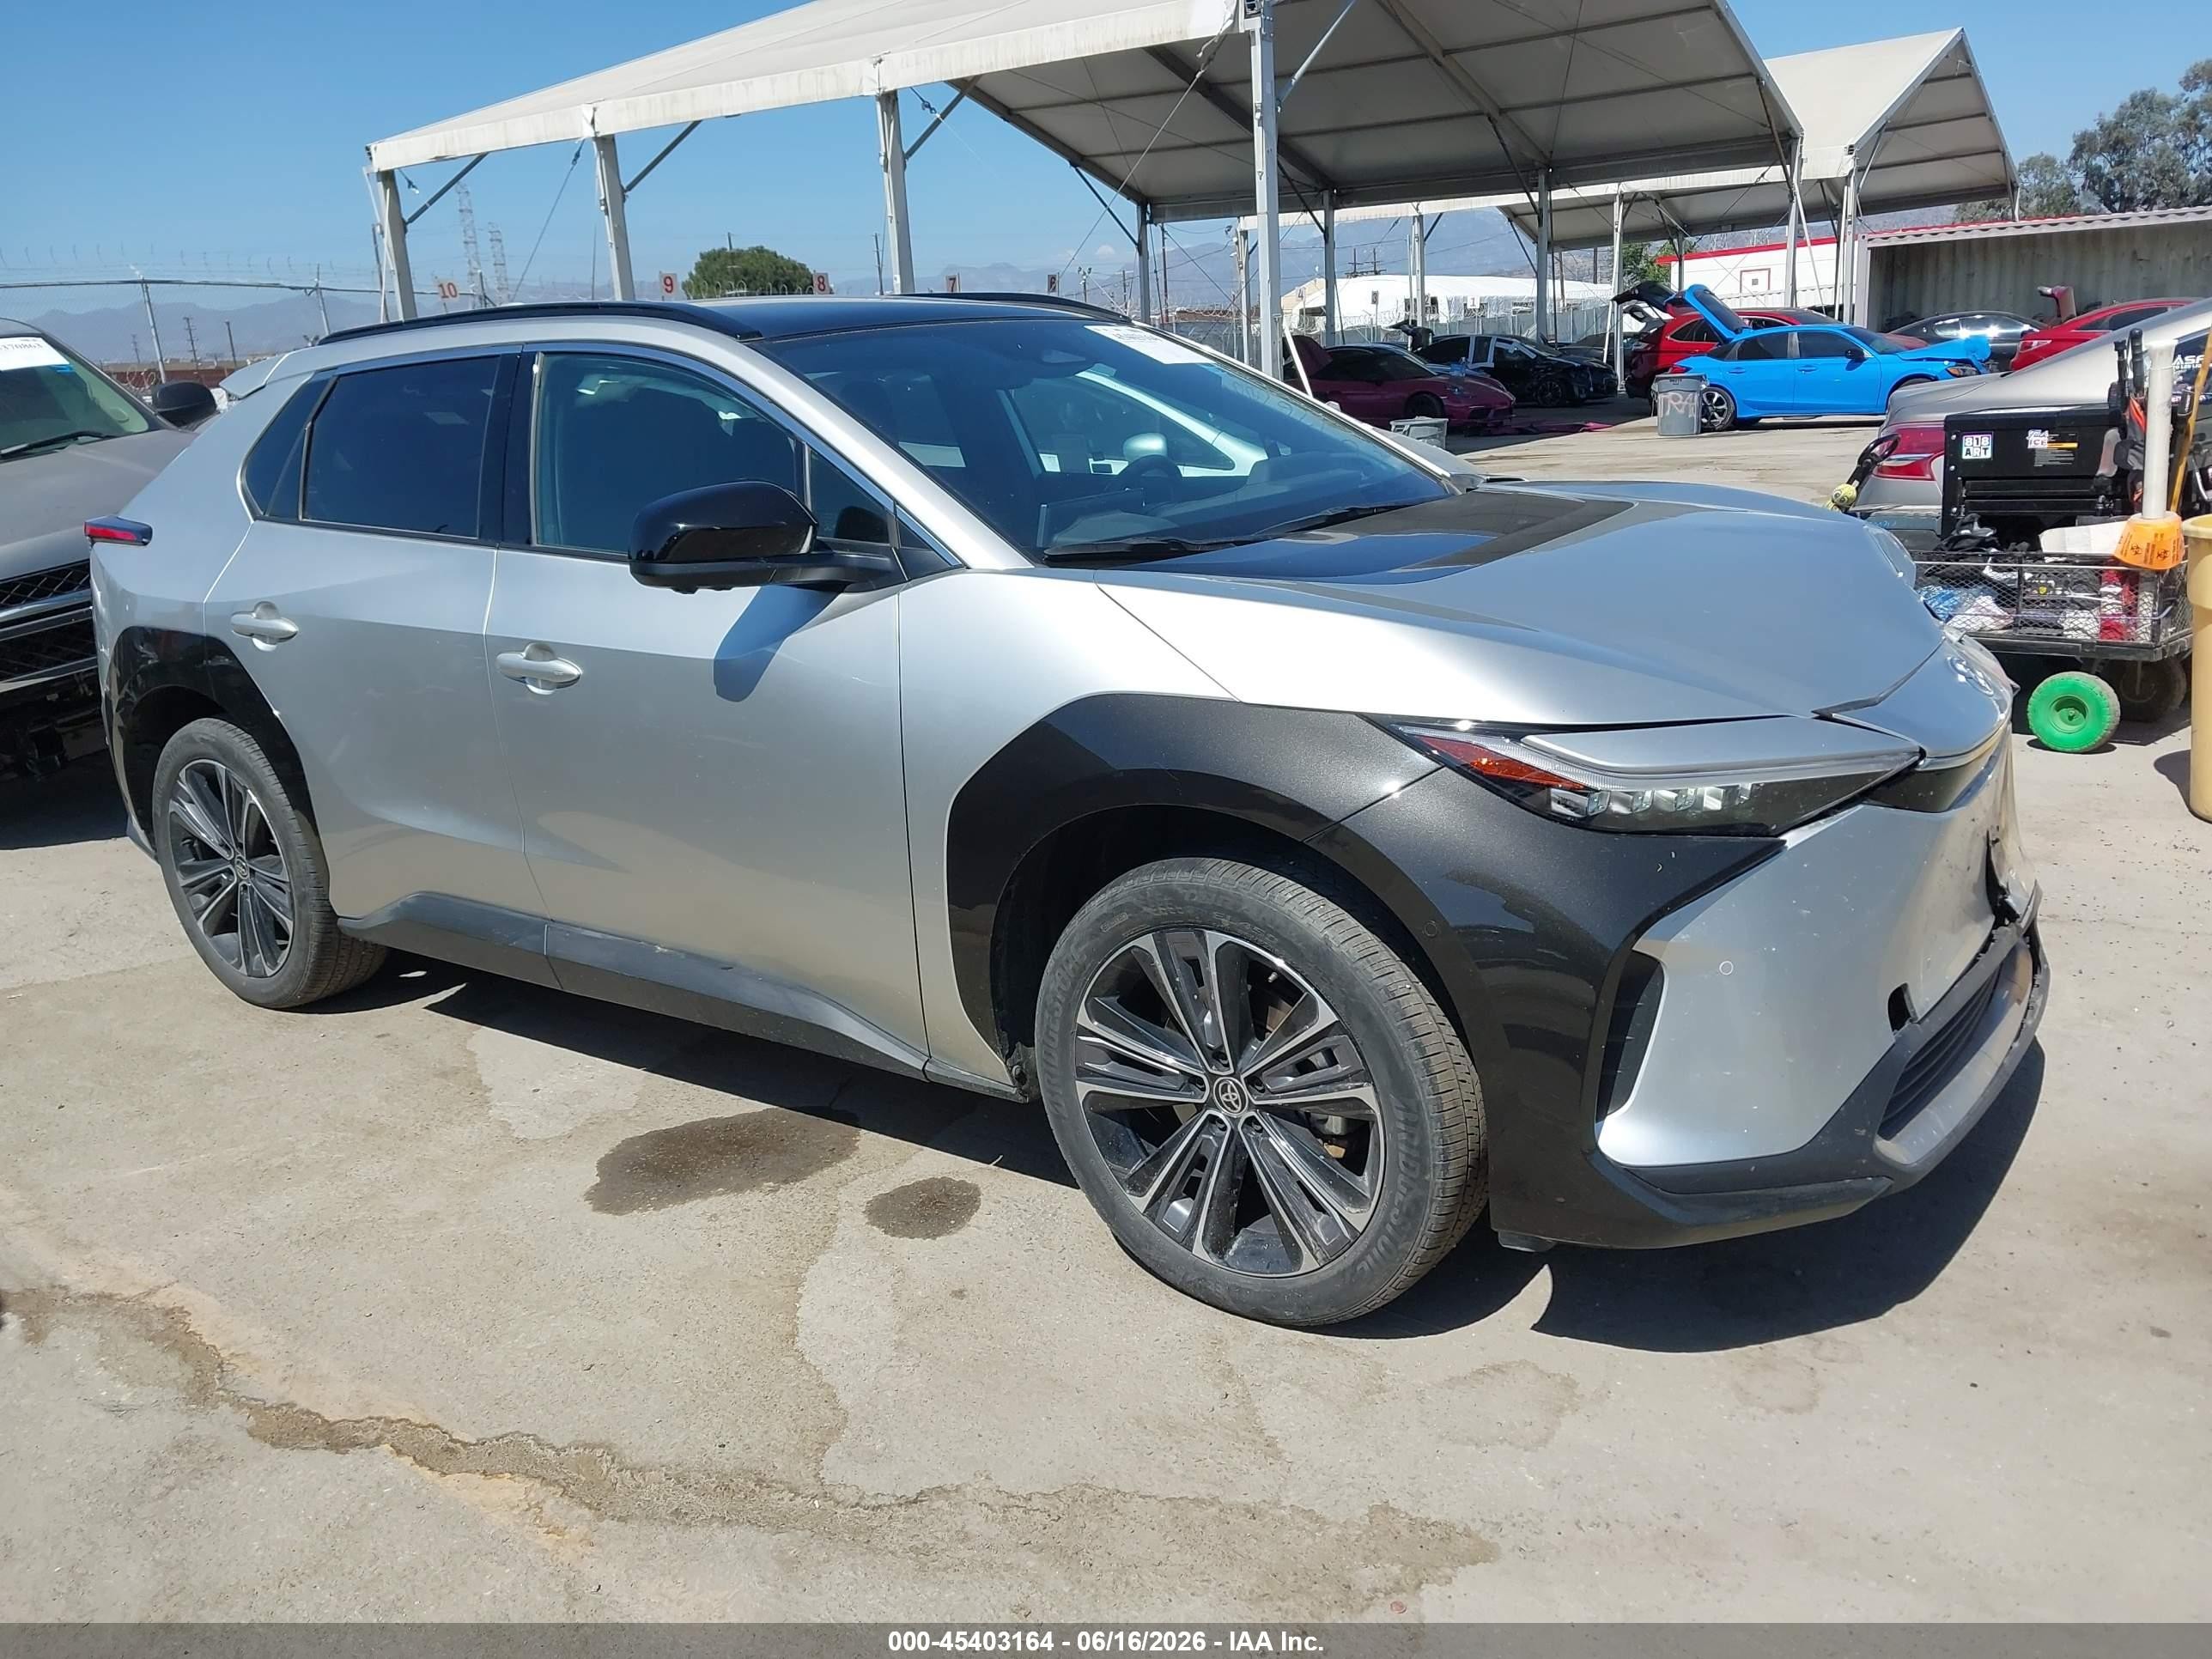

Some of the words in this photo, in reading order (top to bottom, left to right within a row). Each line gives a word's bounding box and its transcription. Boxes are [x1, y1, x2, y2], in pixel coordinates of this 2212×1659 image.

[439, 283, 458, 299] 10
[664, 276, 673, 294] 9
[817, 275, 825, 292] 8
[949, 276, 957, 293] 7
[1469, 297, 1477, 307] 1
[1965, 436, 1990, 447] 818
[1965, 447, 1989, 457] ART
